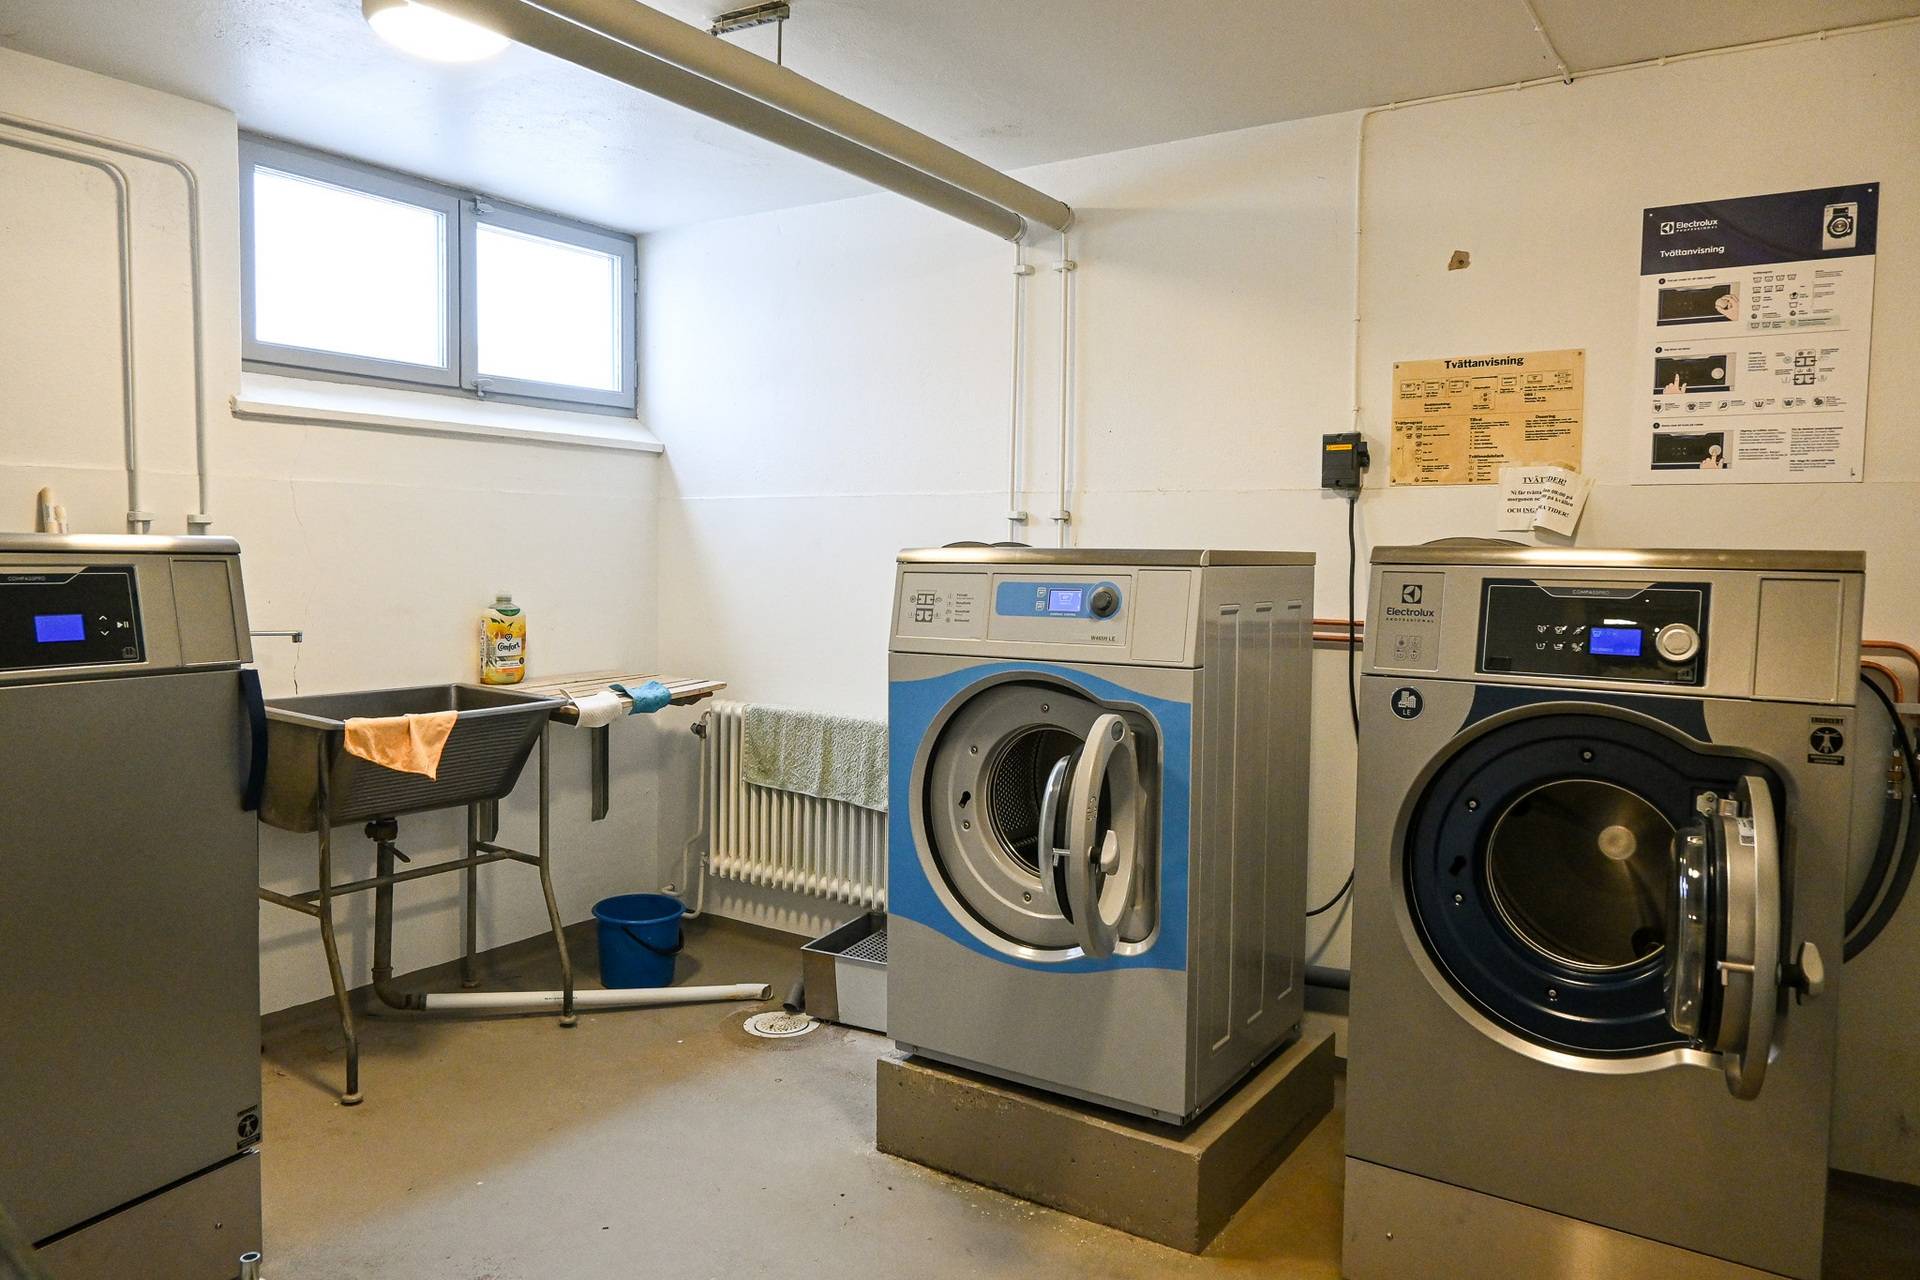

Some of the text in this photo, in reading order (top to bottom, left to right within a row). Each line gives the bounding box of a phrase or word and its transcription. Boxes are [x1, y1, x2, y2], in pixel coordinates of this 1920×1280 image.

[1676, 219, 1718, 229] Electrolux
[1660, 246, 1725, 258] Tvättanvisning
[1445, 356, 1524, 369] Tvättanvisning
[1547, 506, 1569, 518] TIDER!
[1386, 606, 1435, 617] Electrolux
[497, 642, 520, 652] Comfort
